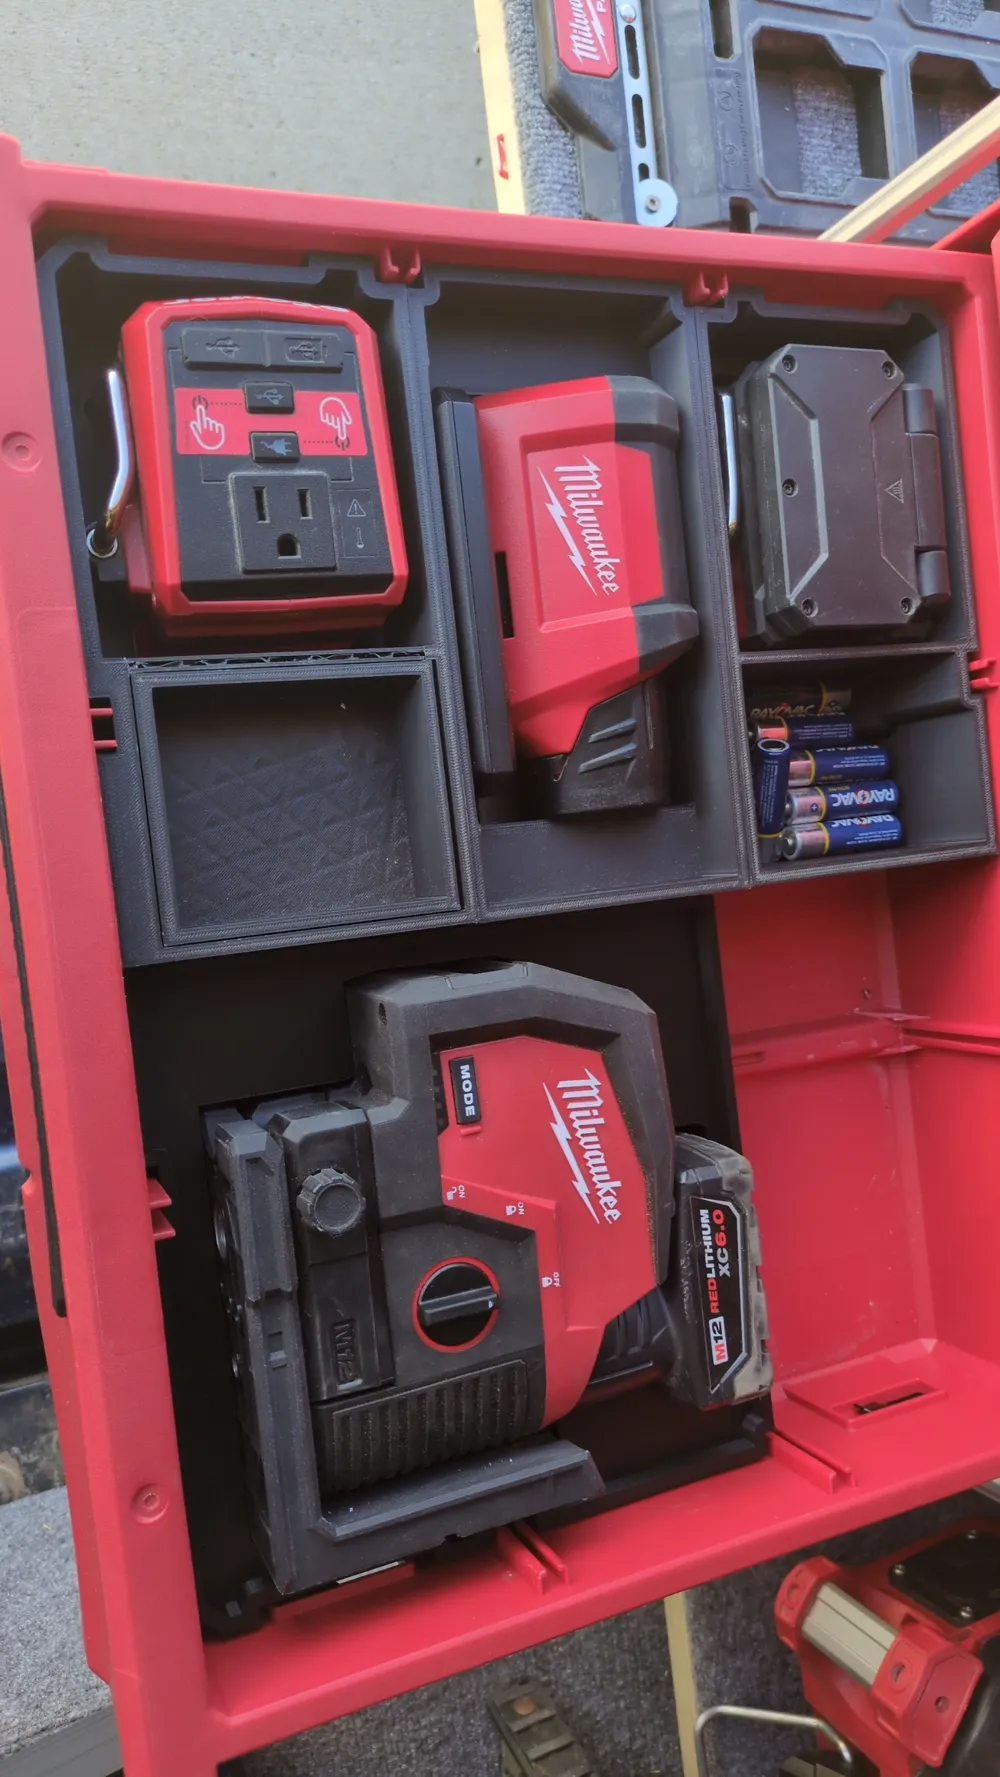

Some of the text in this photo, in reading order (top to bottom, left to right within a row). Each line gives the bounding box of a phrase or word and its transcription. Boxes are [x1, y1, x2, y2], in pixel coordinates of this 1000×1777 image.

[553, 454, 620, 596] Milwaukee
[829, 788, 895, 807] RAYOVAC
[459, 1064, 476, 1117] MODE
[556, 1067, 622, 1225] Milwaukee
[458, 1184, 466, 1198] ON
[517, 1202, 525, 1215] ON
[553, 1272, 561, 1287] OFF
[711, 1321, 727, 1362] M12
